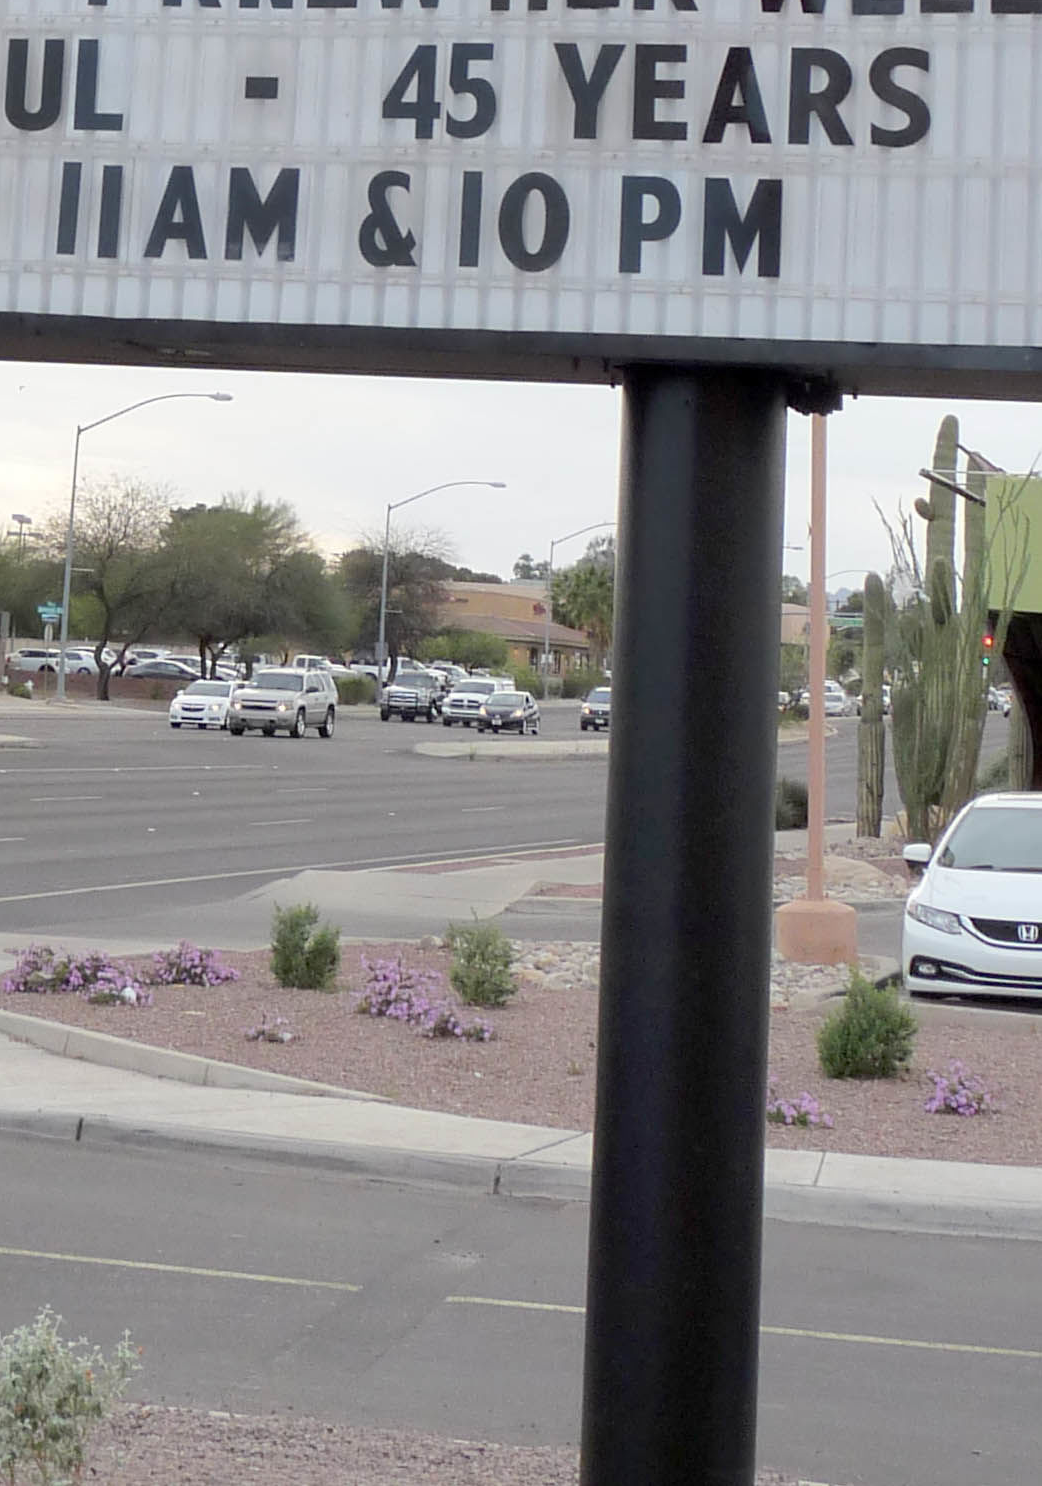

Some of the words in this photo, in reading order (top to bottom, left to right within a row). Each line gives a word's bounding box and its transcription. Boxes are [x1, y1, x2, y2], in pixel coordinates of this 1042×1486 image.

[381, 42, 498, 140] 45
[553, 42, 932, 149] YEARS
[358, 169, 418, 268] &
[458, 170, 571, 273] 10
[618, 175, 784, 279] PM
